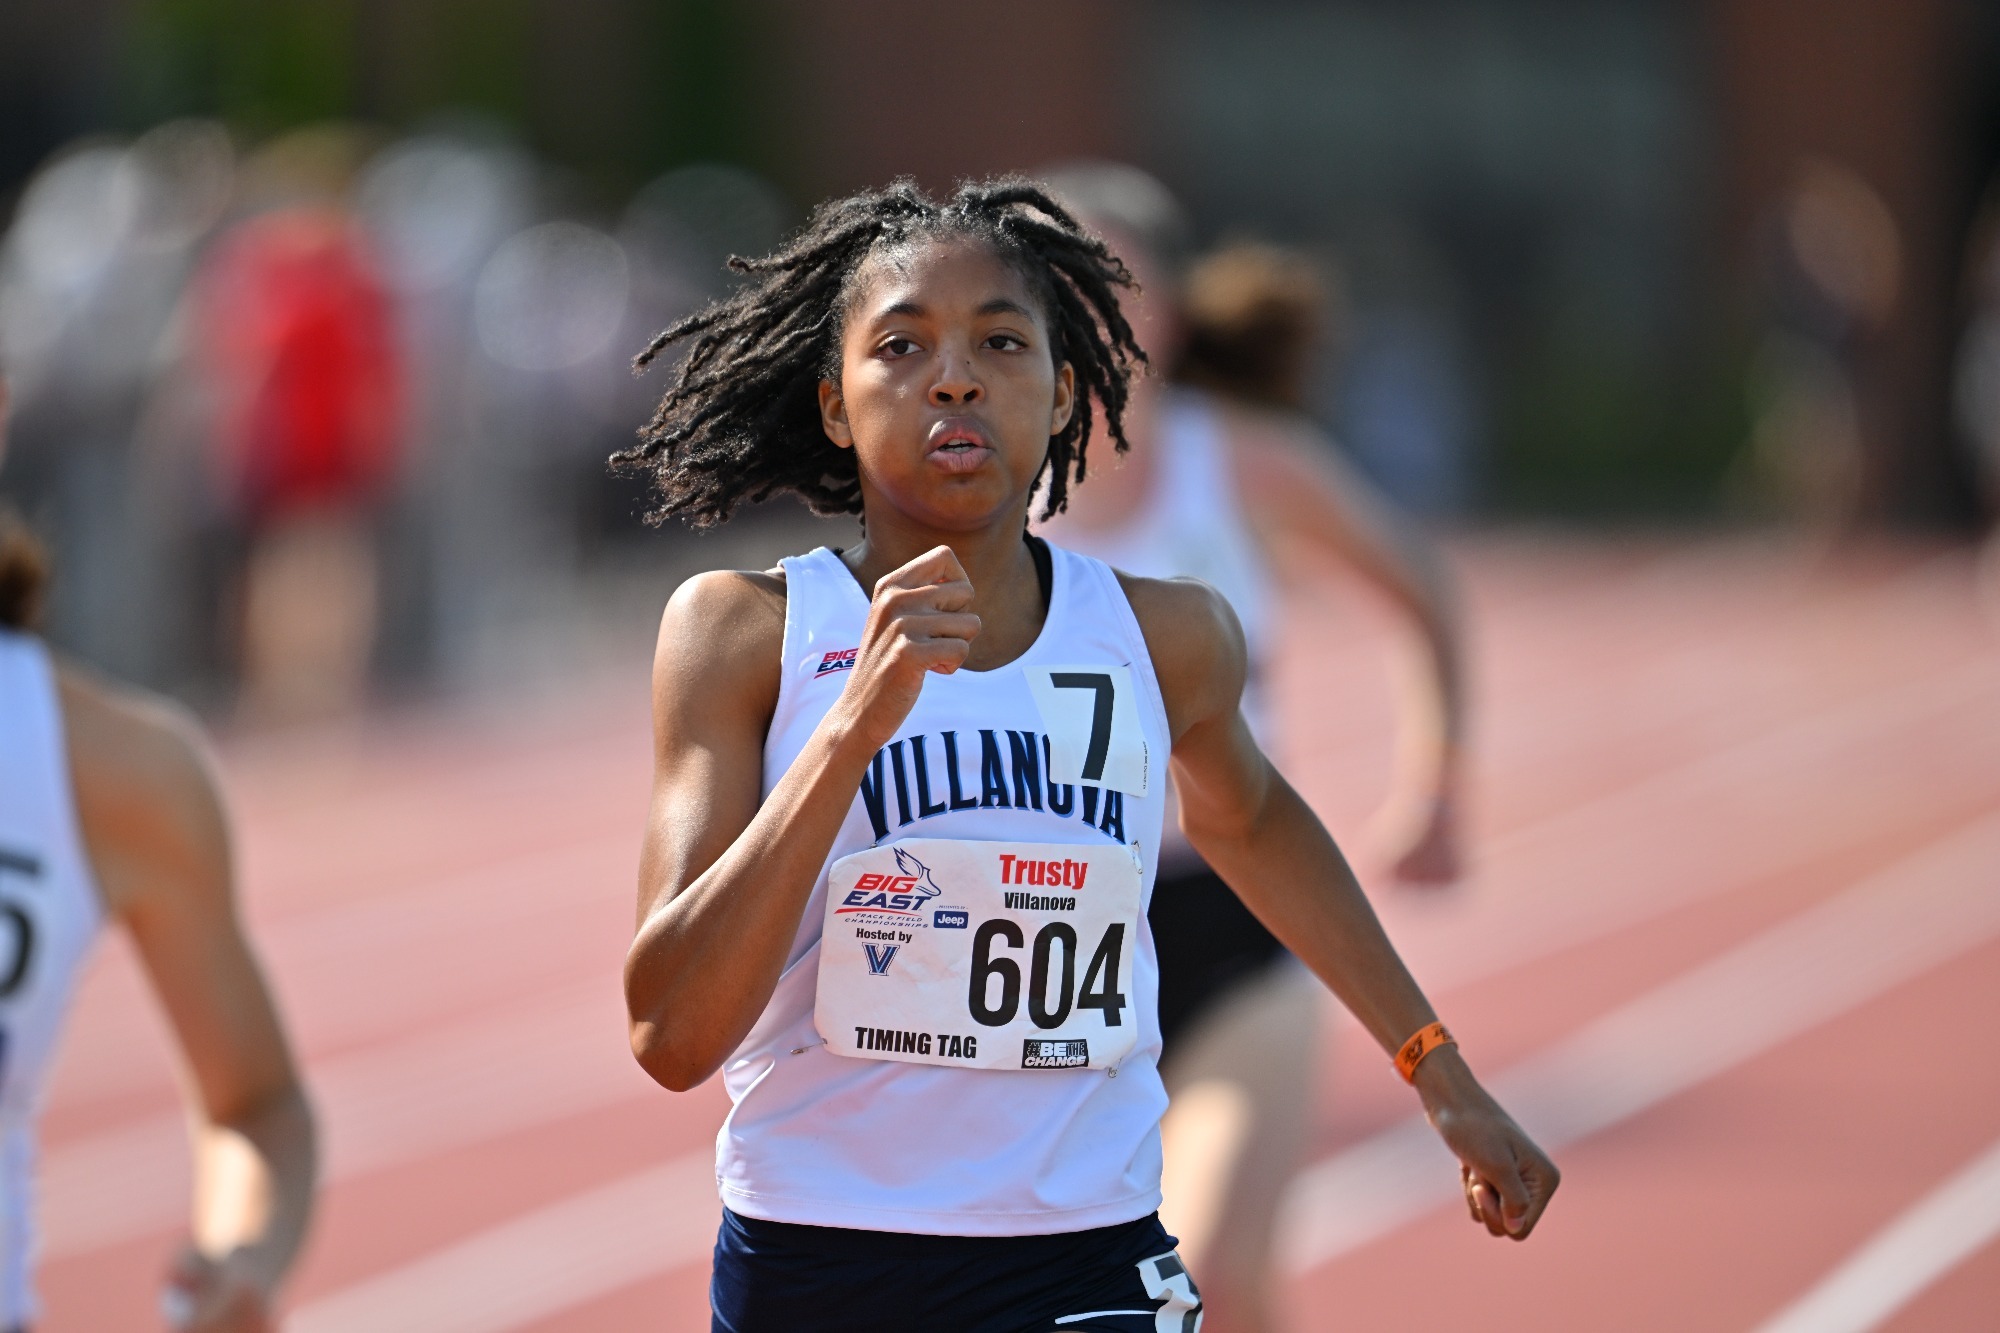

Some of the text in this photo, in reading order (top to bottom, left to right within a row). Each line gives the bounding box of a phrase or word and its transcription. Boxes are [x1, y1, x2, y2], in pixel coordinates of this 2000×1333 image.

[822, 647, 859, 662] BIG
[816, 658, 856, 673] EAS
[1049, 672, 1115, 781] 7
[999, 854, 1089, 891] Trusty
[854, 873, 919, 893] BIG
[842, 890, 932, 911] EAST
[1004, 892, 1076, 911] Villanova
[844, 917, 929, 929] CHAMPIONSHIPS
[937, 913, 965, 927] Jeep
[856, 927, 913, 944] Hosted by
[861, 941, 901, 977] V
[968, 918, 1127, 1030] 604
[855, 1026, 977, 1059] TIMING TAG
[1024, 1055, 1087, 1067] CHANGE
